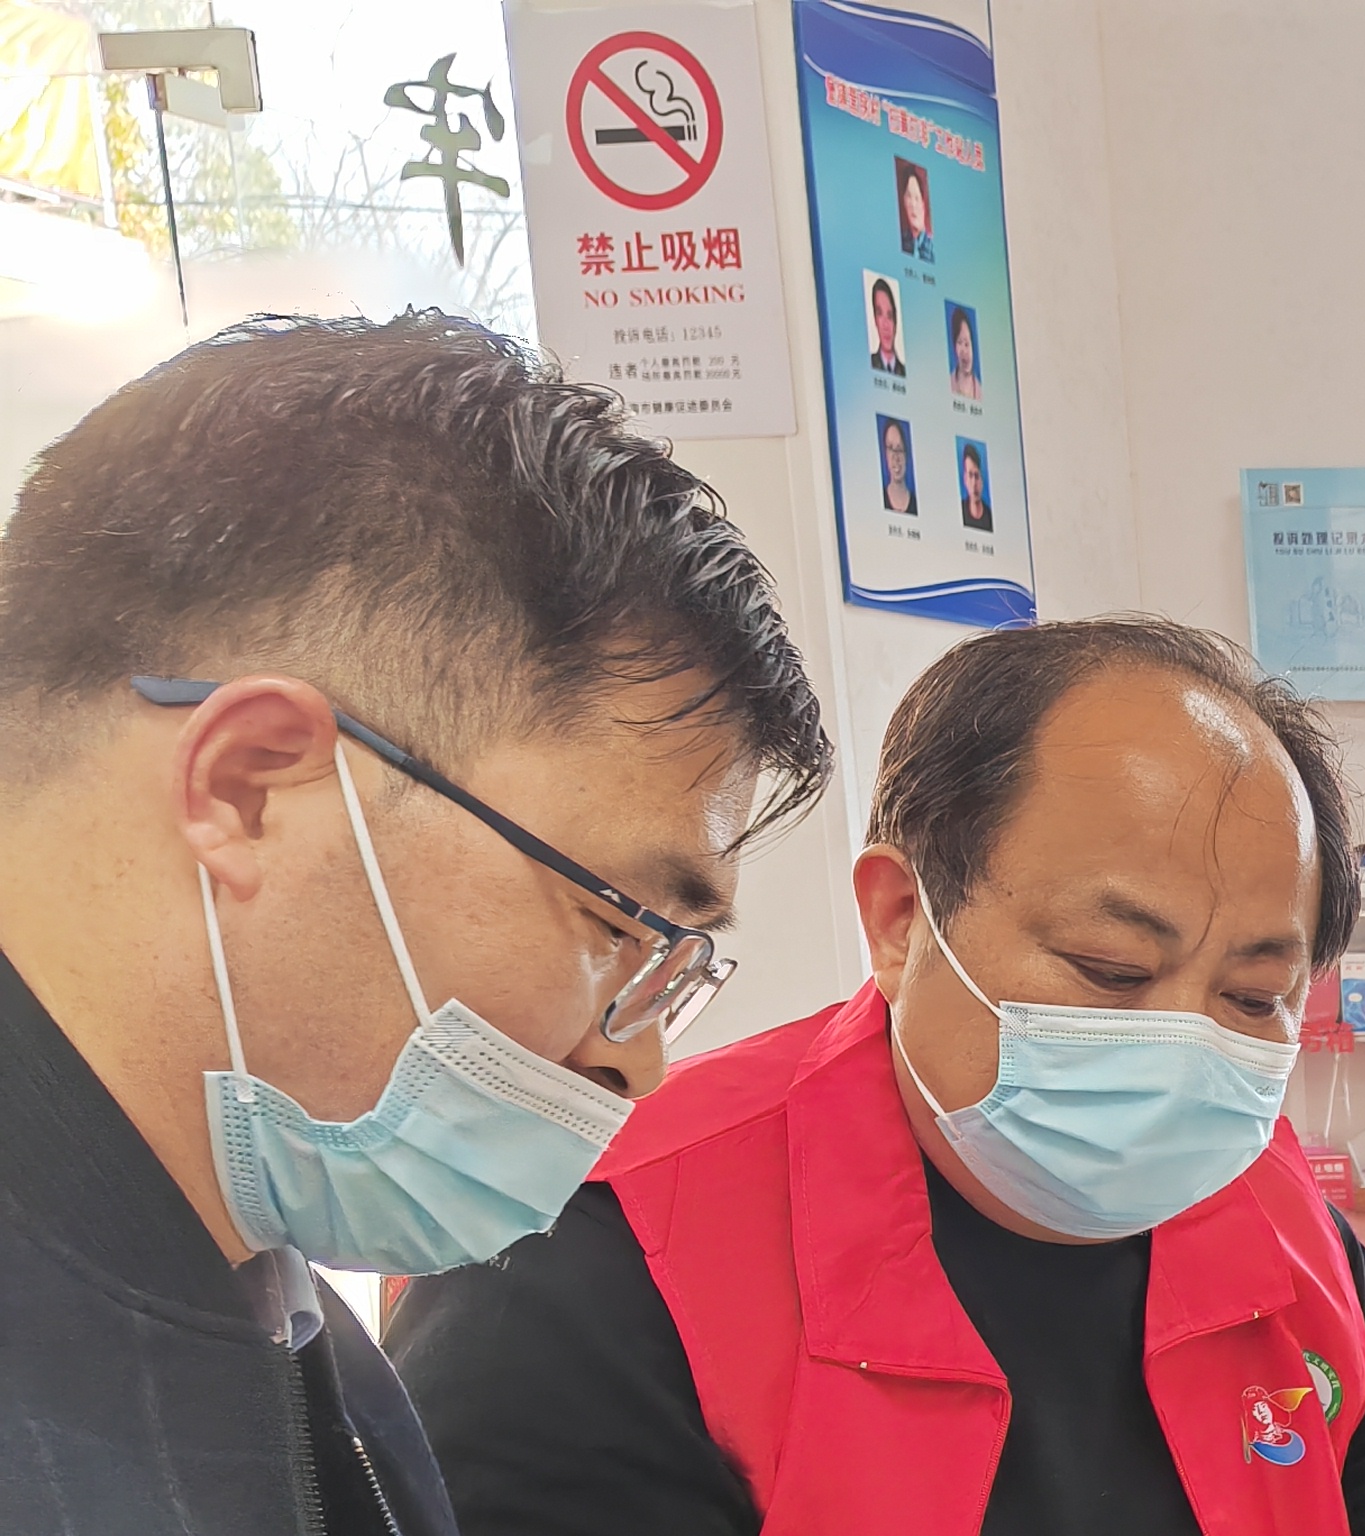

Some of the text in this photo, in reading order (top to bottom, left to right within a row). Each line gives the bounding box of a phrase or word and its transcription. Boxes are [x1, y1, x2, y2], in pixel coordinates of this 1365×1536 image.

[576, 227, 742, 276] 禁止吸烟
[584, 284, 745, 309] NO SMOKING
